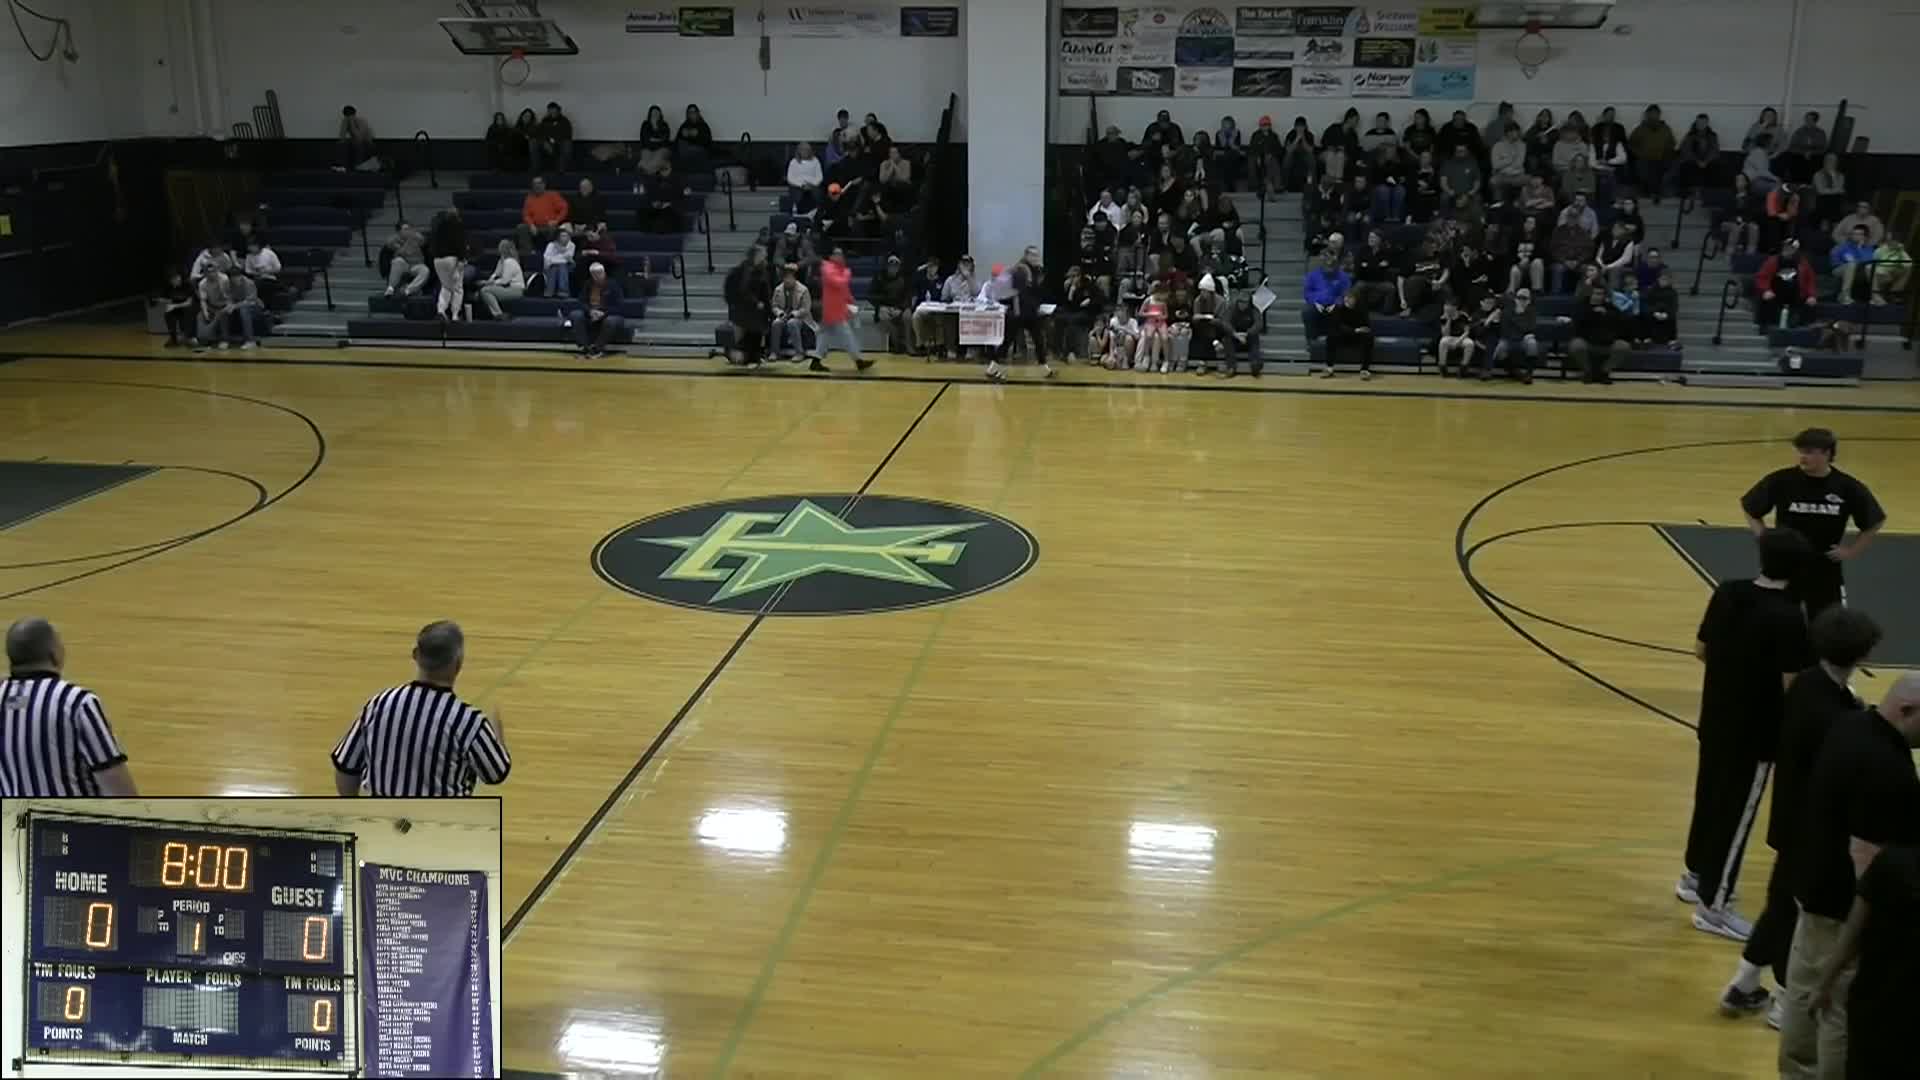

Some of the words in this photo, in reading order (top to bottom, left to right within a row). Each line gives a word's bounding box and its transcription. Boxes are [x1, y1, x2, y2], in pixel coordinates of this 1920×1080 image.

[161, 841, 248, 890] 8:00
[55, 871, 108, 894] HOME
[379, 868, 403, 882] MVC
[406, 870, 470, 886] CHAMPIONS
[272, 886, 325, 908] GUEST
[158, 910, 164, 920] P
[173, 899, 211, 914] PERIOD
[86, 902, 113, 948] 0
[218, 914, 224, 924] P
[193, 922, 201, 951] 1
[303, 916, 328, 960] 0
[34, 963, 54, 977] TM
[58, 965, 96, 979] FOULS
[146, 969, 192, 984] PLAYER
[205, 973, 242, 988] FOULS
[285, 976, 304, 991] TM
[306, 978, 341, 992] FOULS
[64, 987, 85, 1020] 0
[313, 999, 332, 1032] 0
[44, 1027, 83, 1040] POINTS
[173, 1033, 208, 1046] MATCH
[295, 1038, 331, 1052] POINTS
